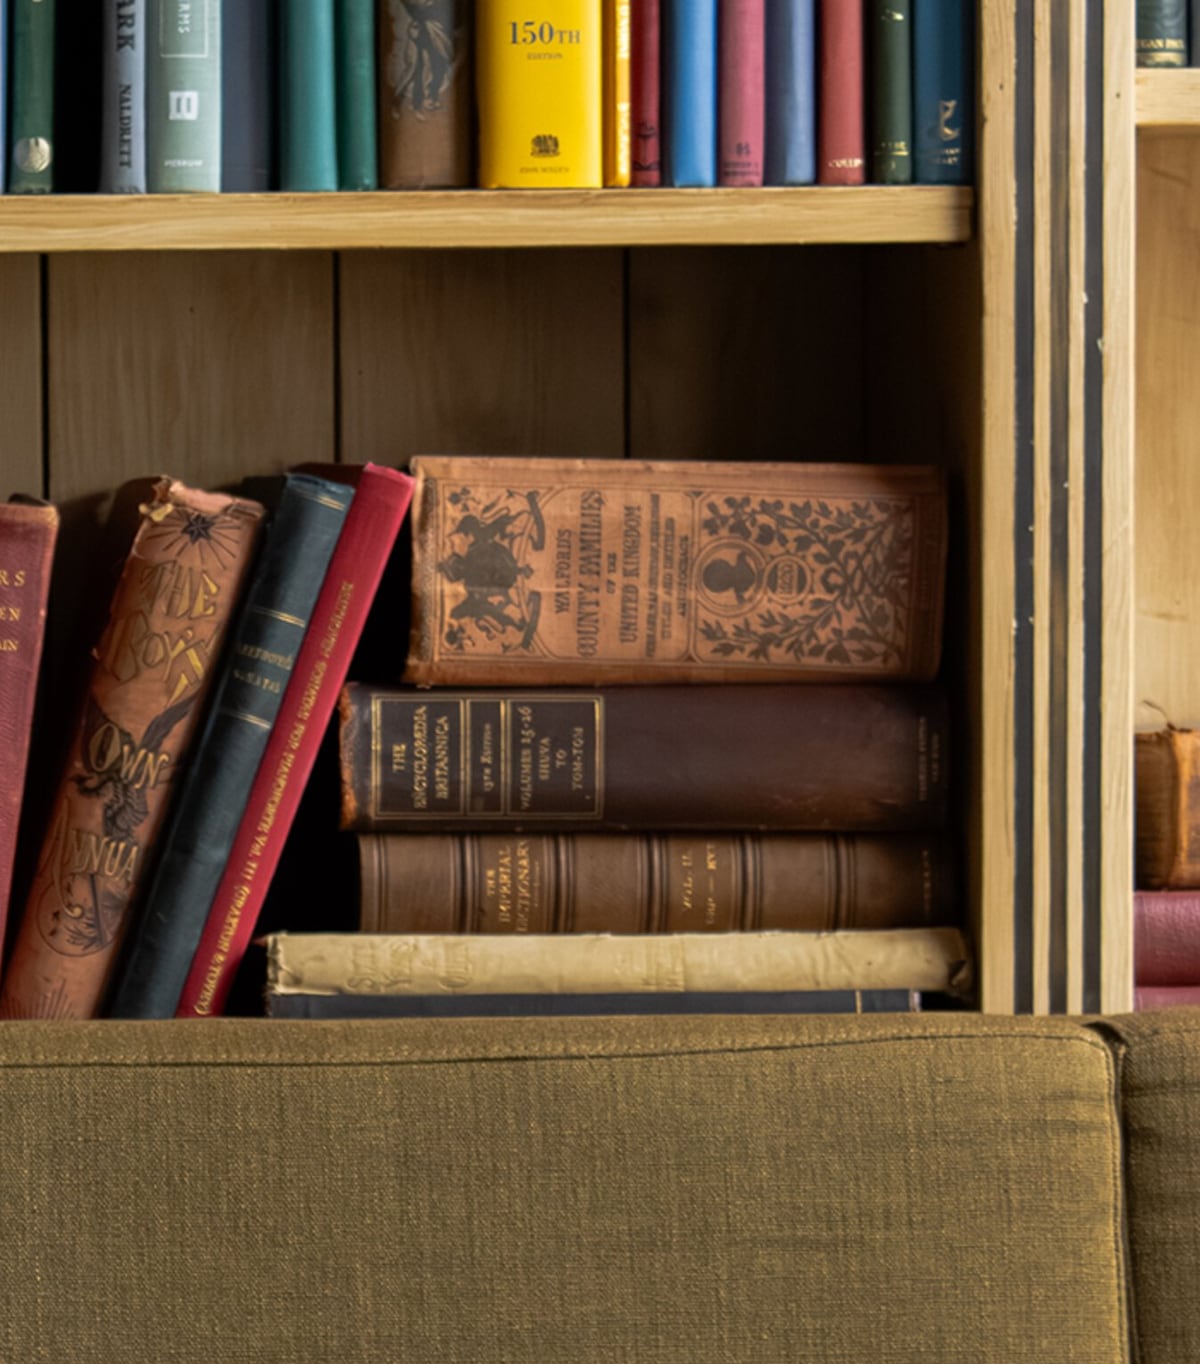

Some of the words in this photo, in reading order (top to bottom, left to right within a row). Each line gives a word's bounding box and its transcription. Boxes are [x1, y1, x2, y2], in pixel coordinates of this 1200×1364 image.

[509, 21, 581, 44] 150TH
[119, 84, 132, 168] NALDRETT
[578, 489, 604, 576] FAMILIES
[606, 552, 617, 575] THE
[622, 505, 642, 578] KINGDOM
[576, 583, 599, 657] COUNTY
[619, 584, 638, 643] UNITED
[88, 722, 170, 789] OWN
[391, 742, 407, 773] THE
[434, 714, 450, 800] BRITANNICA
[555, 747, 568, 769] TO
[571, 726, 585, 791] TOM-TOM
[259, 751, 293, 834] PIANOFORTE
